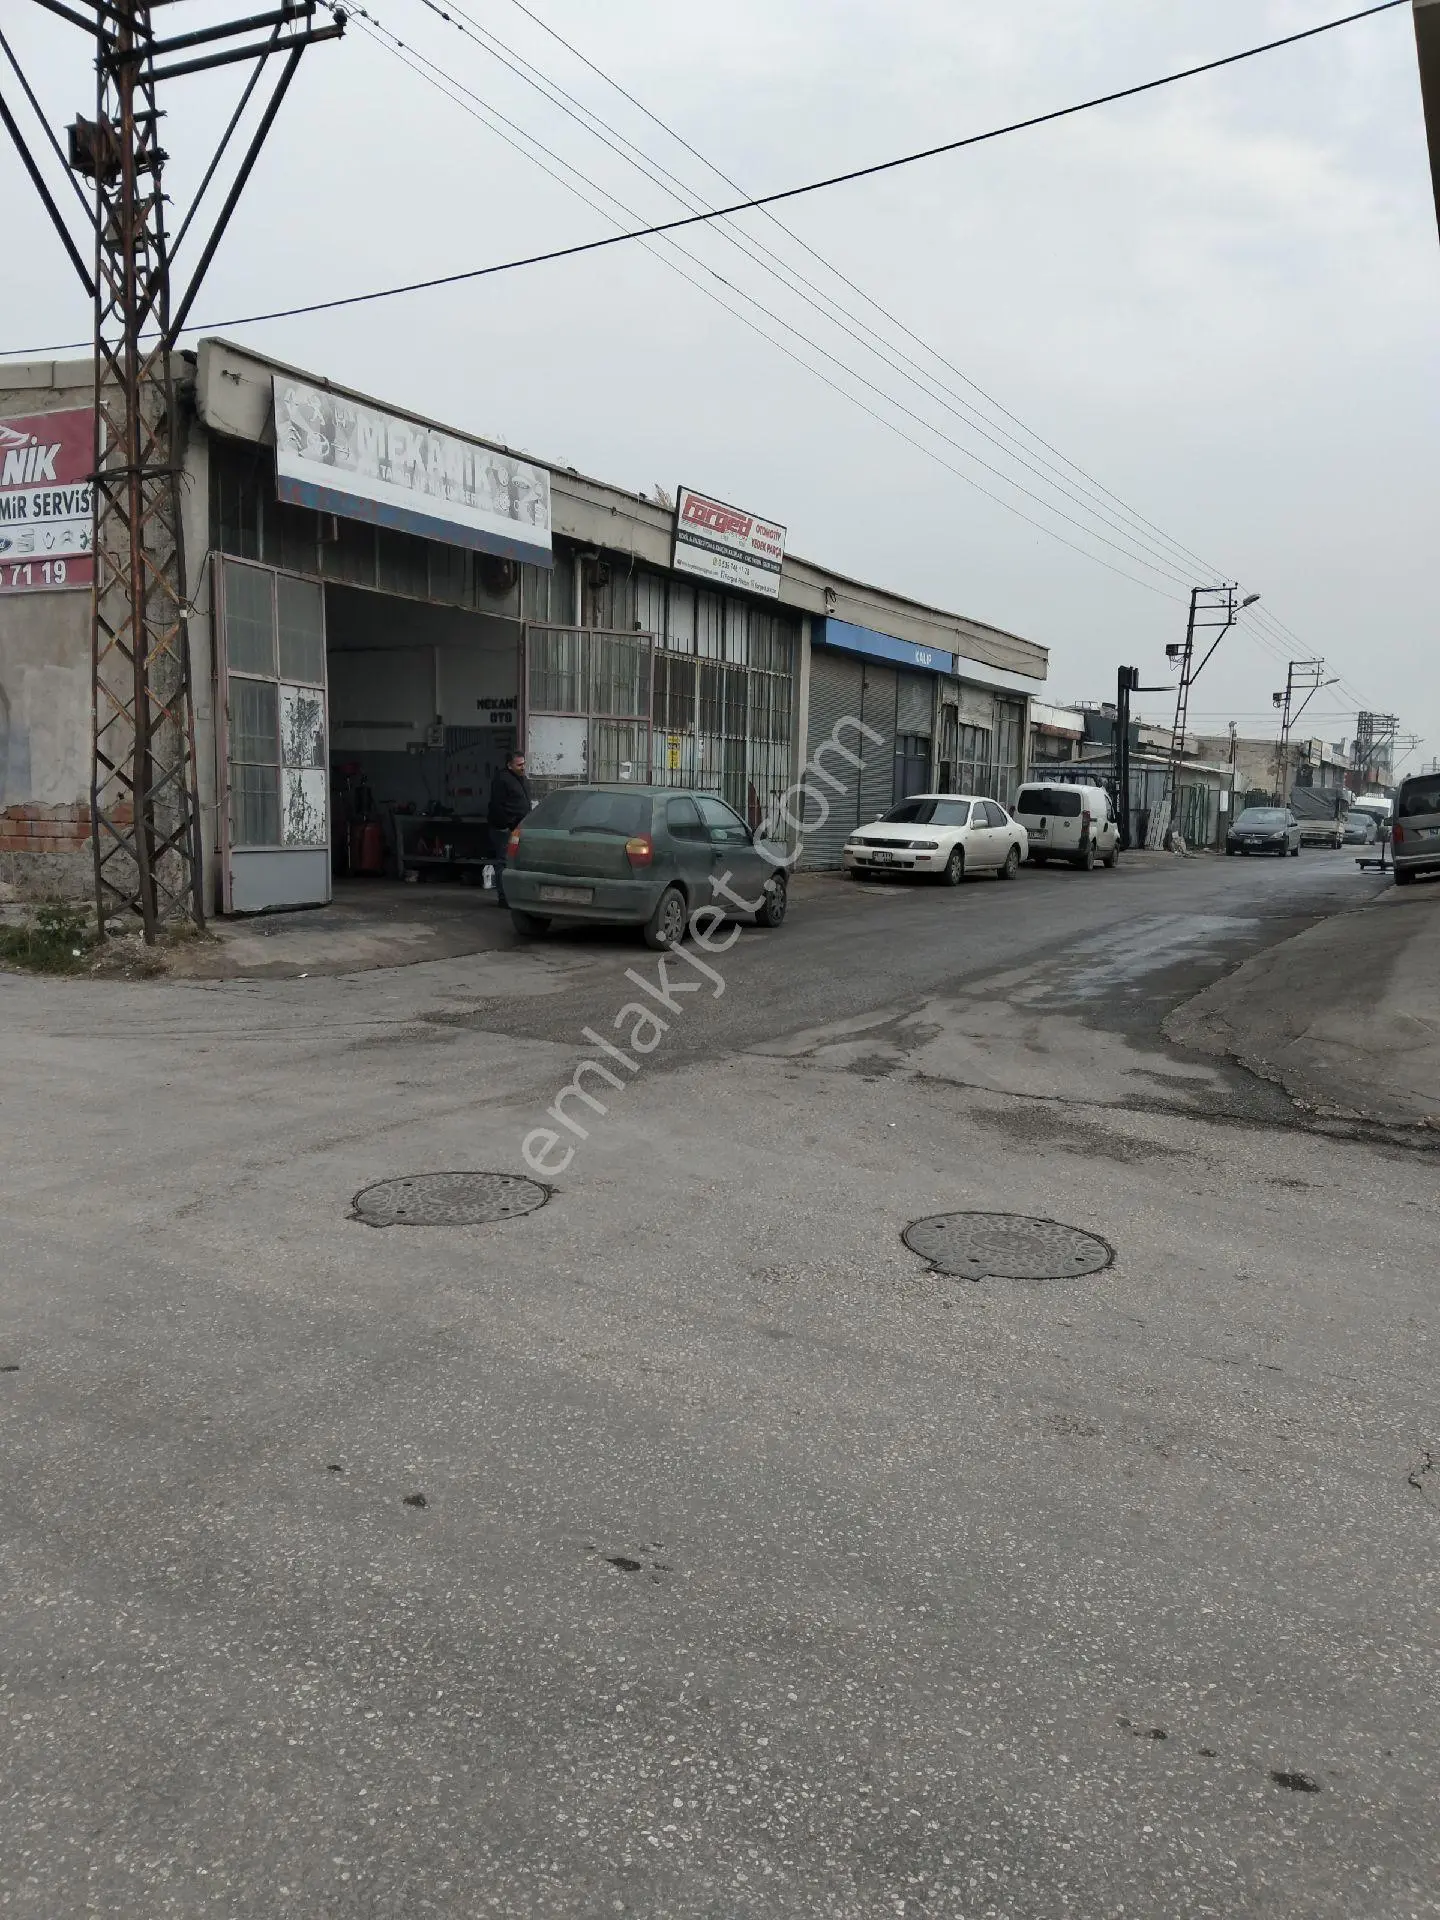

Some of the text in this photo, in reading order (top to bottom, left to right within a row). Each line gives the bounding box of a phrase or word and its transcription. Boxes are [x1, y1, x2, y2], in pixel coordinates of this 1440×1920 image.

[0, 436, 61, 486] NİK
[10, 563, 32, 586] 71
[42, 559, 67, 585] 19
